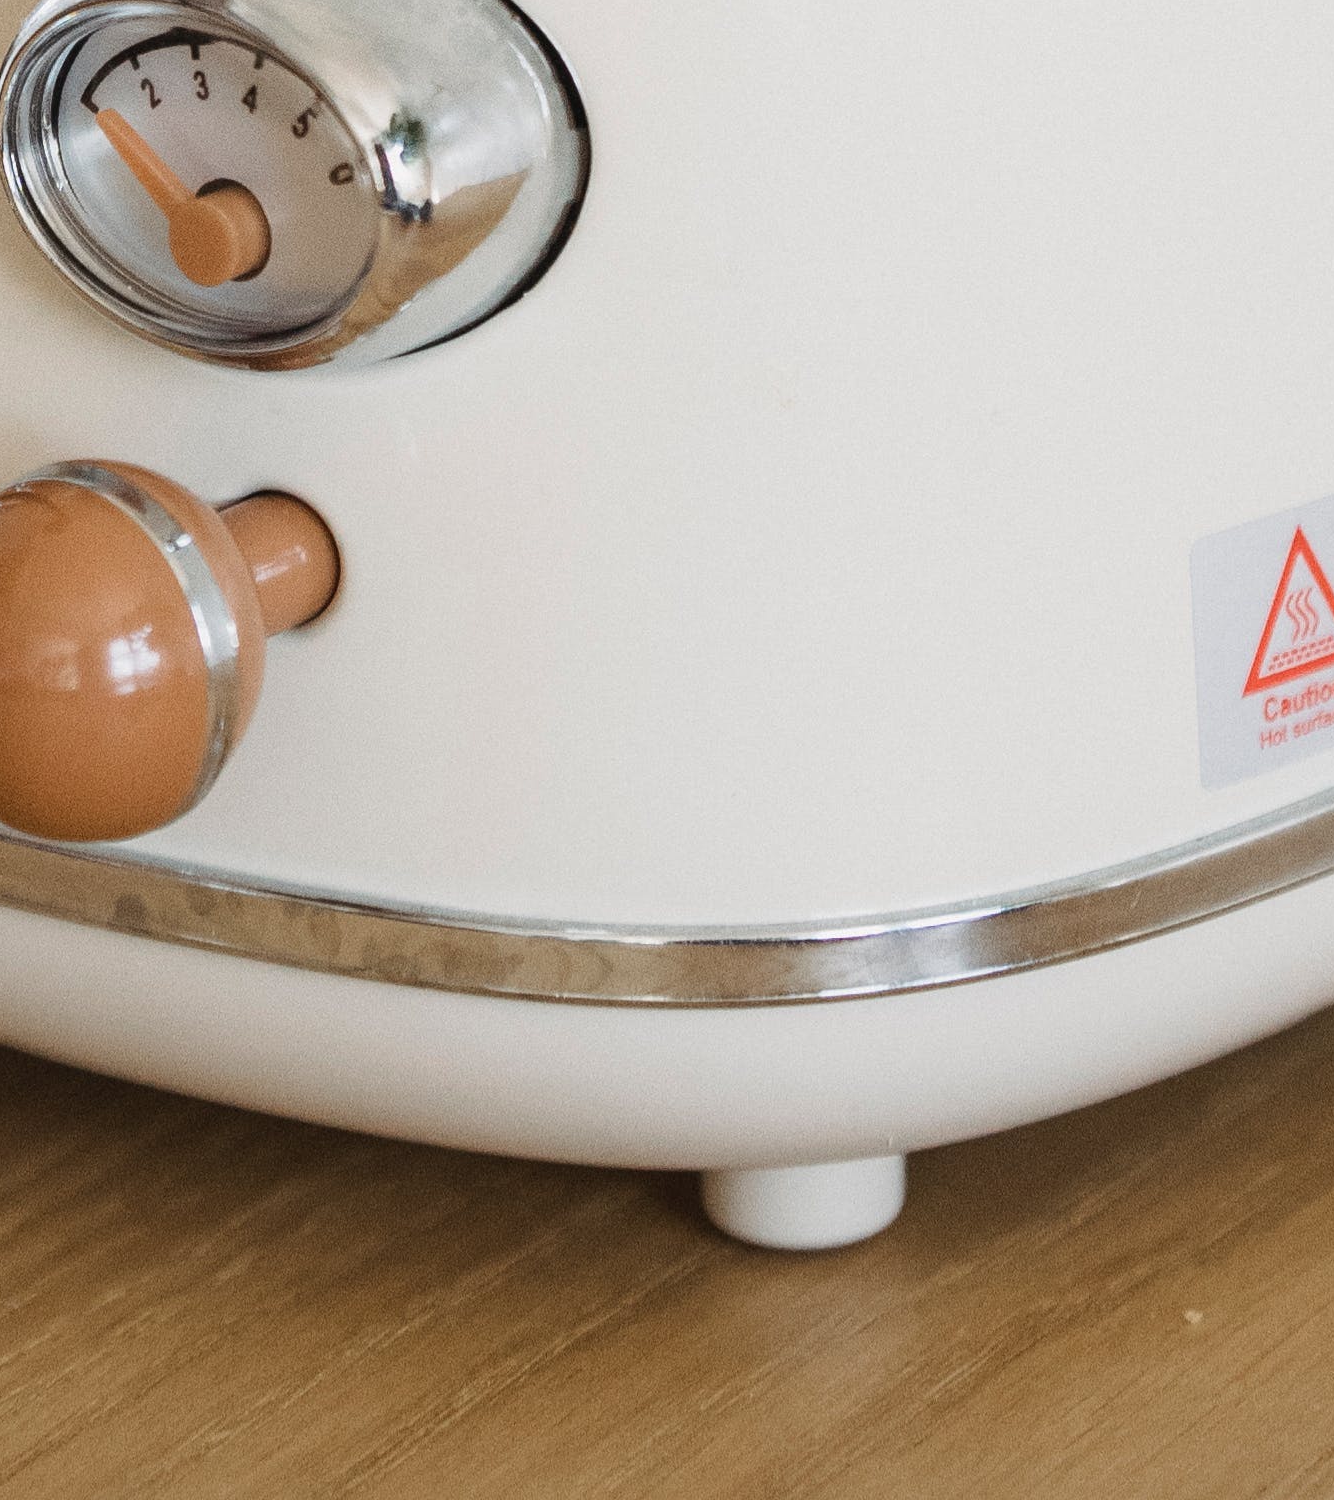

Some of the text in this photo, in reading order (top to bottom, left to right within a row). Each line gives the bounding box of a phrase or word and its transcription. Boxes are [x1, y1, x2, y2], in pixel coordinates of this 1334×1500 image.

[141, 78, 161, 109] 2
[193, 71, 209, 100] 3
[241, 85, 258, 113] 4
[291, 107, 317, 139] 5
[1259, 727, 1287, 749] Hot
